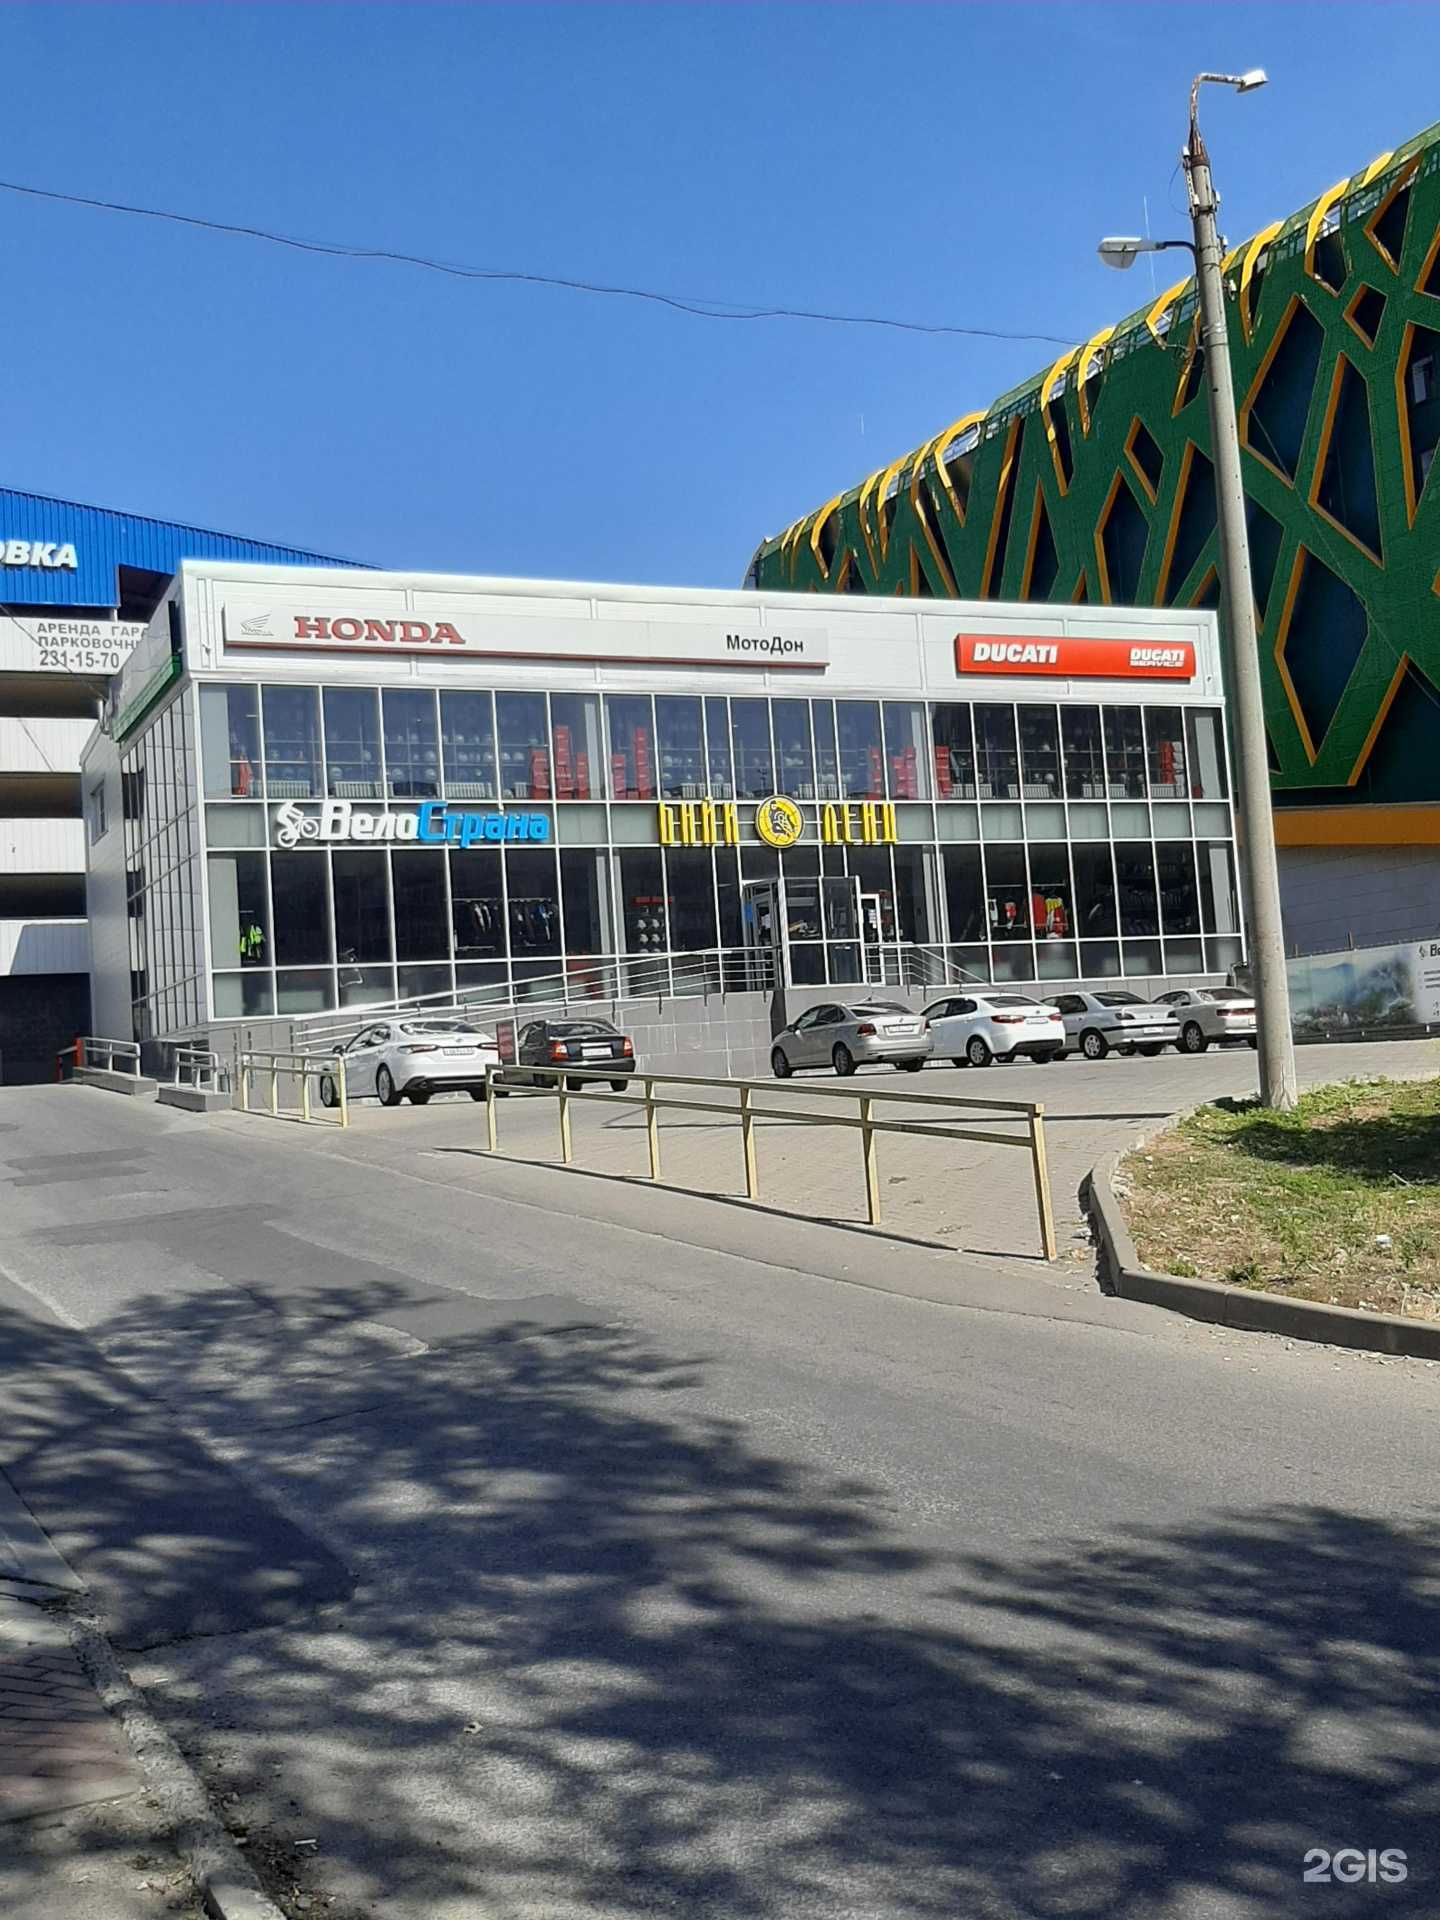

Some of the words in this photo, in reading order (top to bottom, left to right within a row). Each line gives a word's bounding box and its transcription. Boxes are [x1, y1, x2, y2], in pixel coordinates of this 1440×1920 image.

[0, 540, 78, 569] ВКА
[37, 623, 101, 636] АРЕНДА
[294, 616, 466, 645] HONDA
[38, 636, 138, 649] ПАРКОВОЧН
[726, 634, 804, 655] МотоДон
[40, 650, 119, 668] 231-15-70
[973, 643, 1058, 664] DUCATI
[1130, 648, 1185, 661] DUCATI
[319, 799, 550, 848] ВелоСтрана
